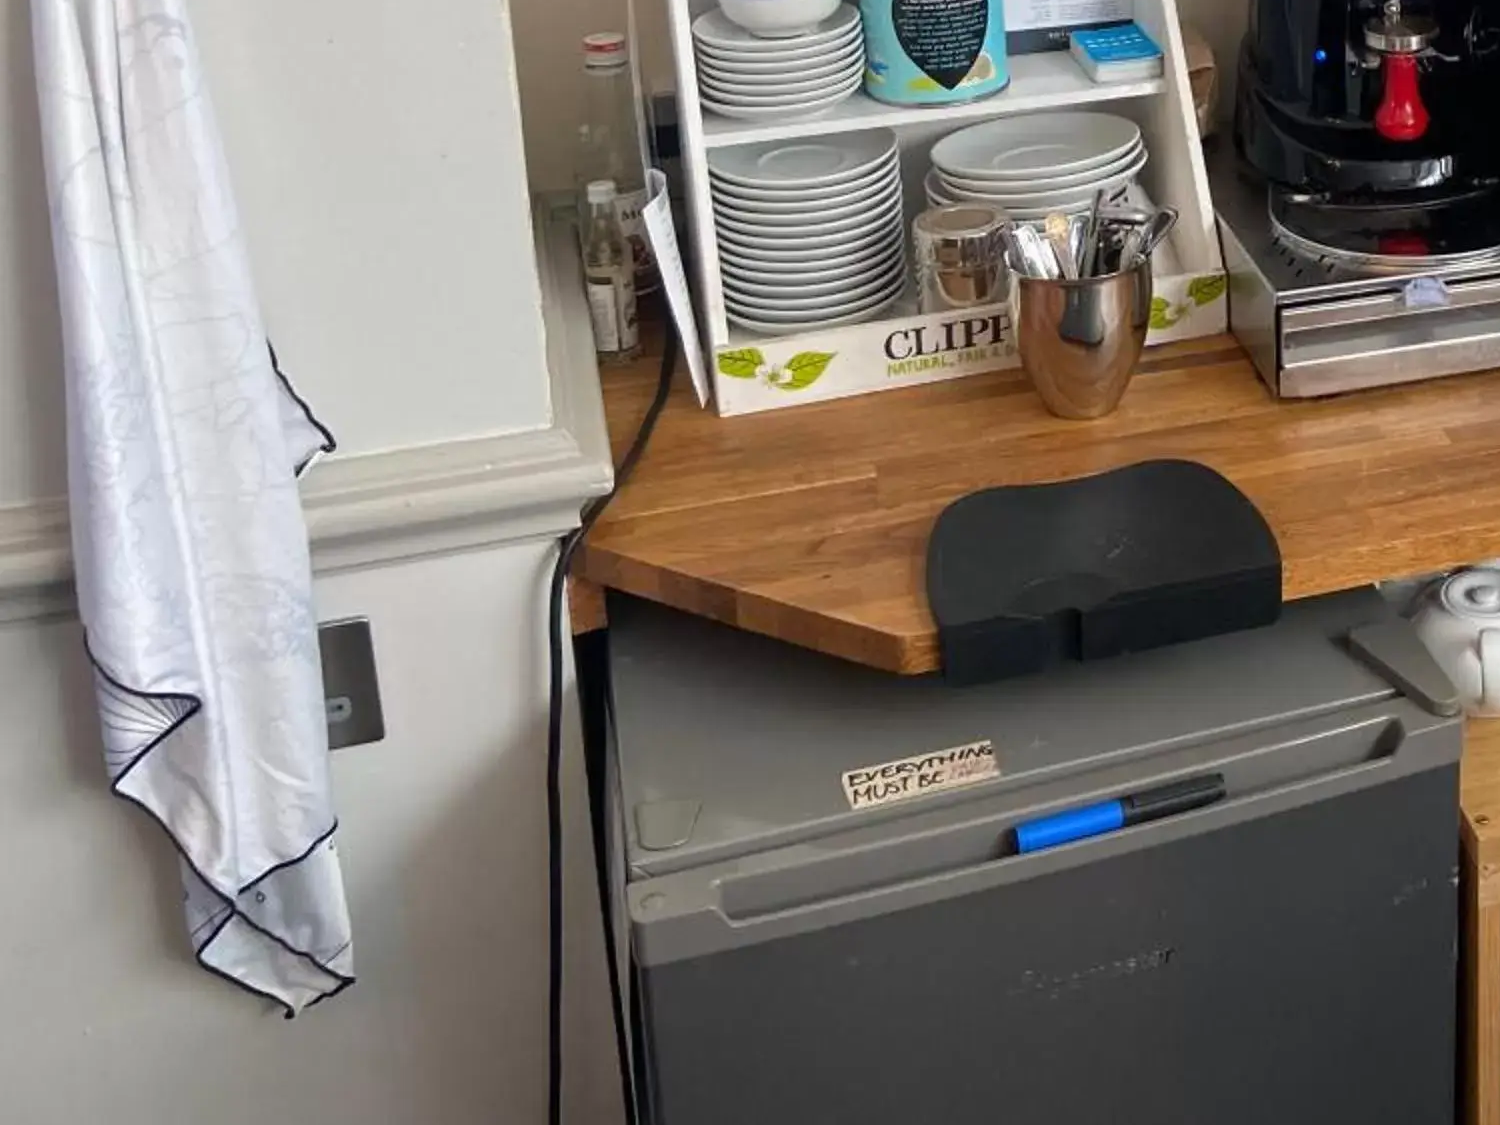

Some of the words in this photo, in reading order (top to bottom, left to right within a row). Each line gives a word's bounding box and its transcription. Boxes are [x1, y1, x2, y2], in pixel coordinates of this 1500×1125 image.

[884, 314, 1012, 360] CLIPP
[848, 744, 994, 788] EVERYTHING
[852, 776, 912, 805] MUST
